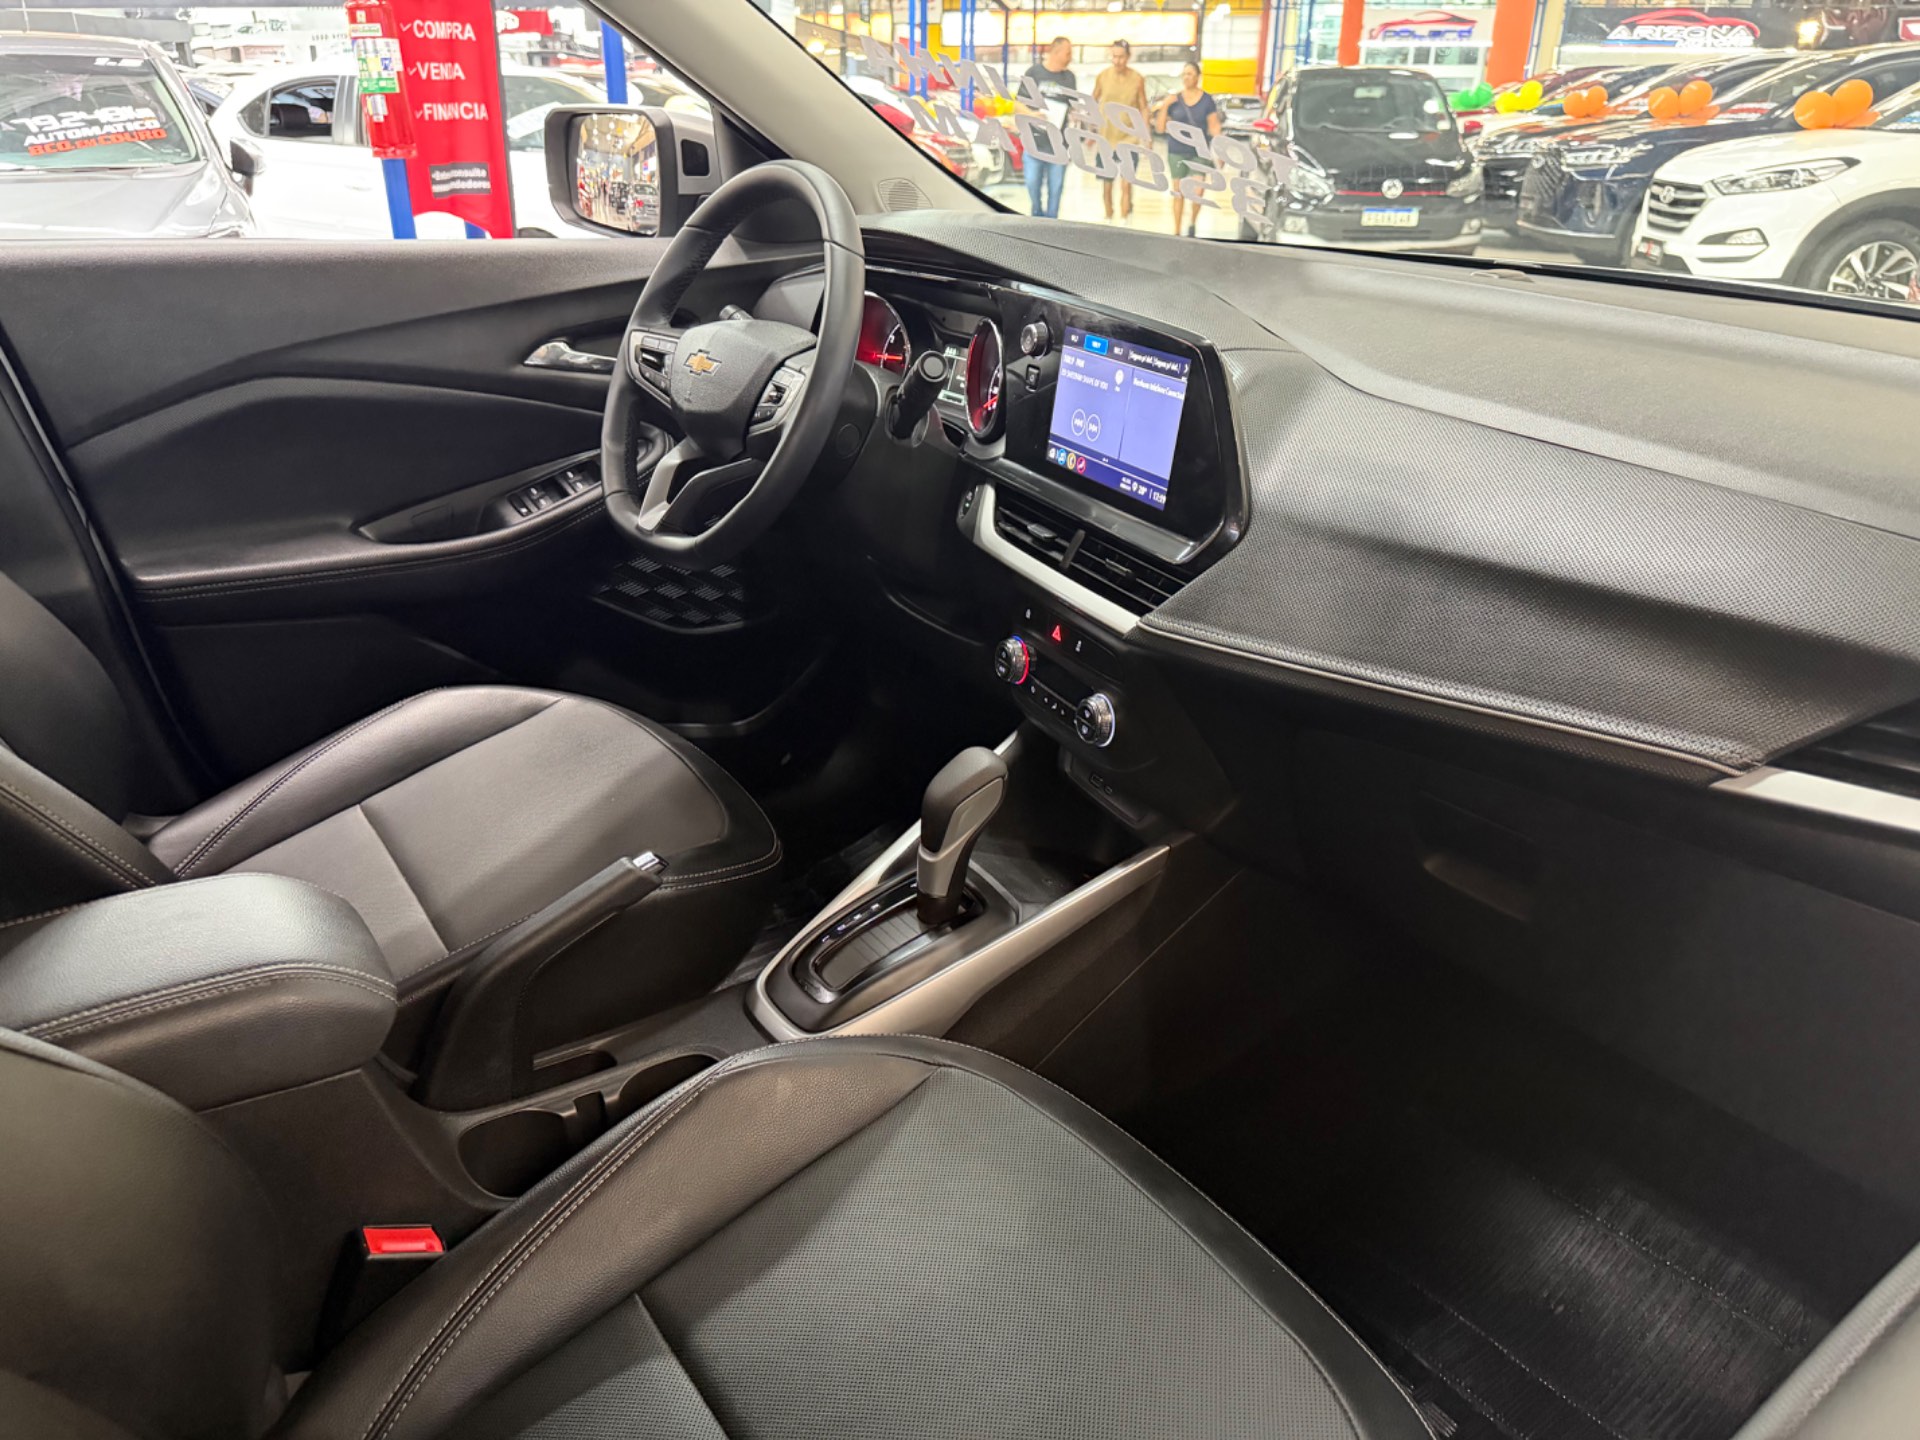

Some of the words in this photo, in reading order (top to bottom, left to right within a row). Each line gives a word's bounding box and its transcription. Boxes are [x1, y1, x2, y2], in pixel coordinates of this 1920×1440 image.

[413, 20, 476, 41] COMPRA
[1607, 25, 1754, 40] ARIZONA
[98, 128, 167, 145] COURO
